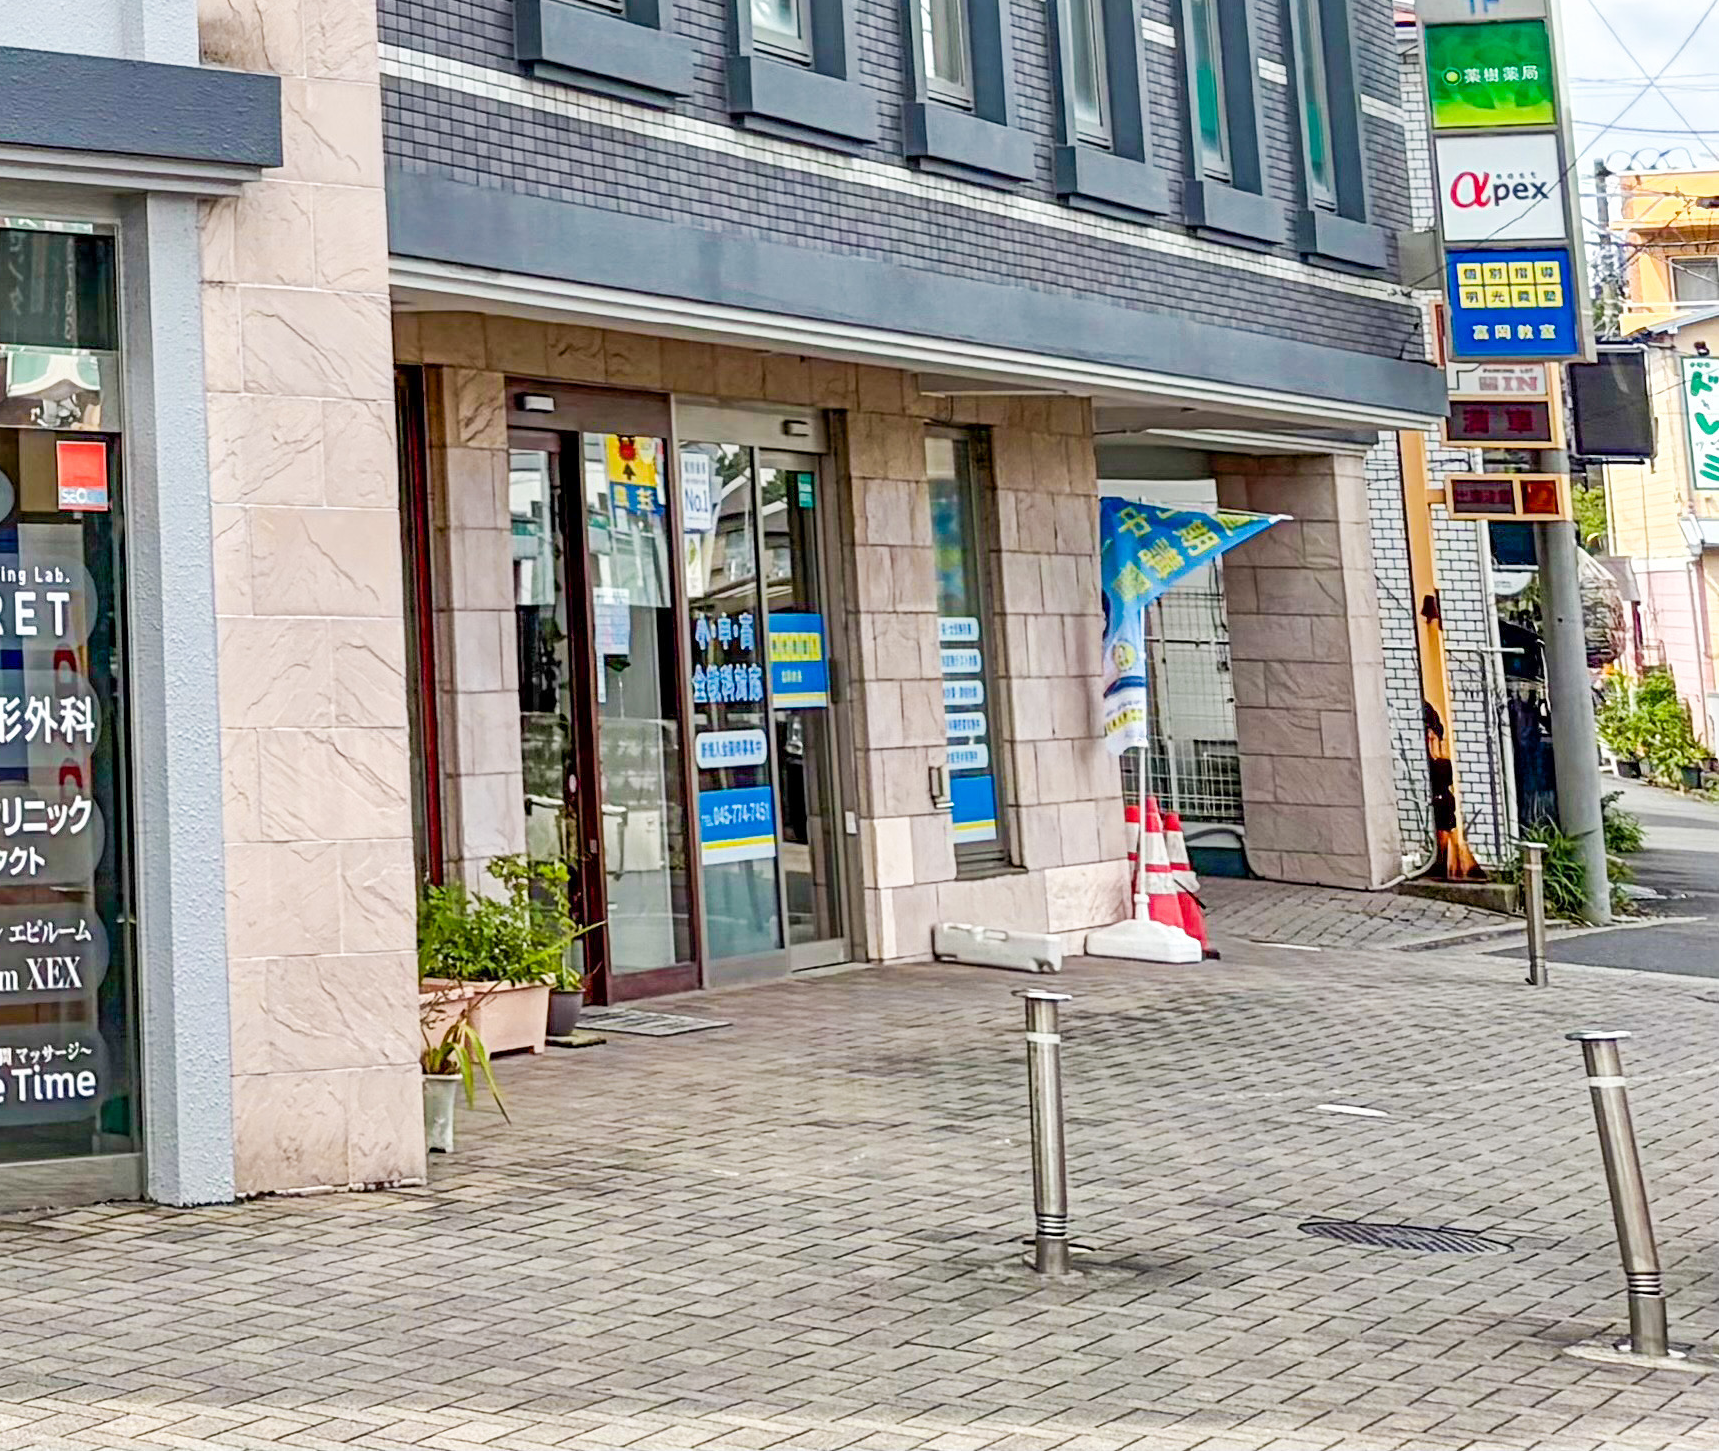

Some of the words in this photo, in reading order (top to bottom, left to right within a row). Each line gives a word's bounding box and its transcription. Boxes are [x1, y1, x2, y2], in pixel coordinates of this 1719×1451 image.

[1464, 65, 1539, 84] 薬樹薬局
[1502, 376, 1538, 391] IN
[35, 566, 71, 584] Lab.
[9, 919, 92, 944] エピルーム
[26, 956, 83, 991] XEX
[11, 1065, 97, 1101] Time
